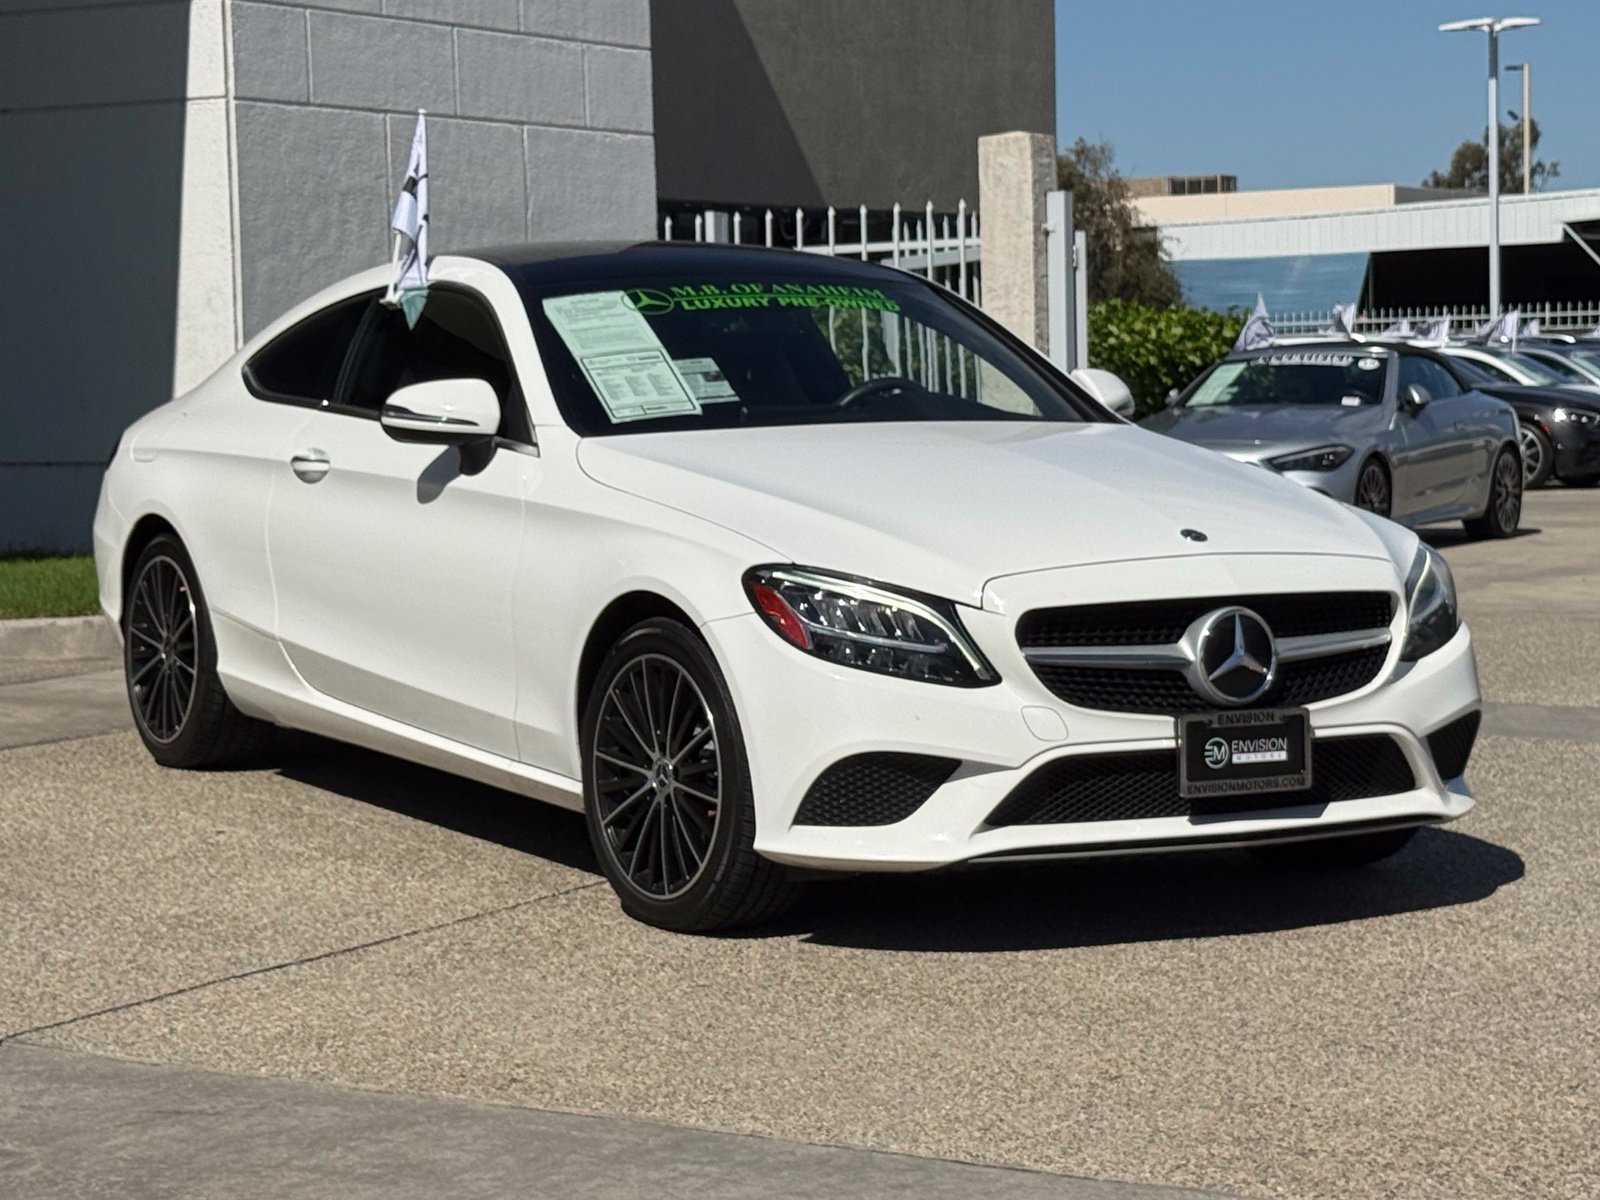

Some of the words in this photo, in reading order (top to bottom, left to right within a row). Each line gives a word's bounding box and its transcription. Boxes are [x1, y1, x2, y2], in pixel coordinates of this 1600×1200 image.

[671, 285, 728, 297] M.B.
[731, 283, 763, 295] OF
[772, 284, 886, 299] ANAHEIM
[681, 297, 769, 311] LUXURY
[777, 297, 900, 311] PRE-OWNED
[1218, 712, 1274, 724] ENVISION
[1232, 738, 1287, 752] ENVISION
[1187, 777, 1305, 794] ENVISIONMOTORS.COM
